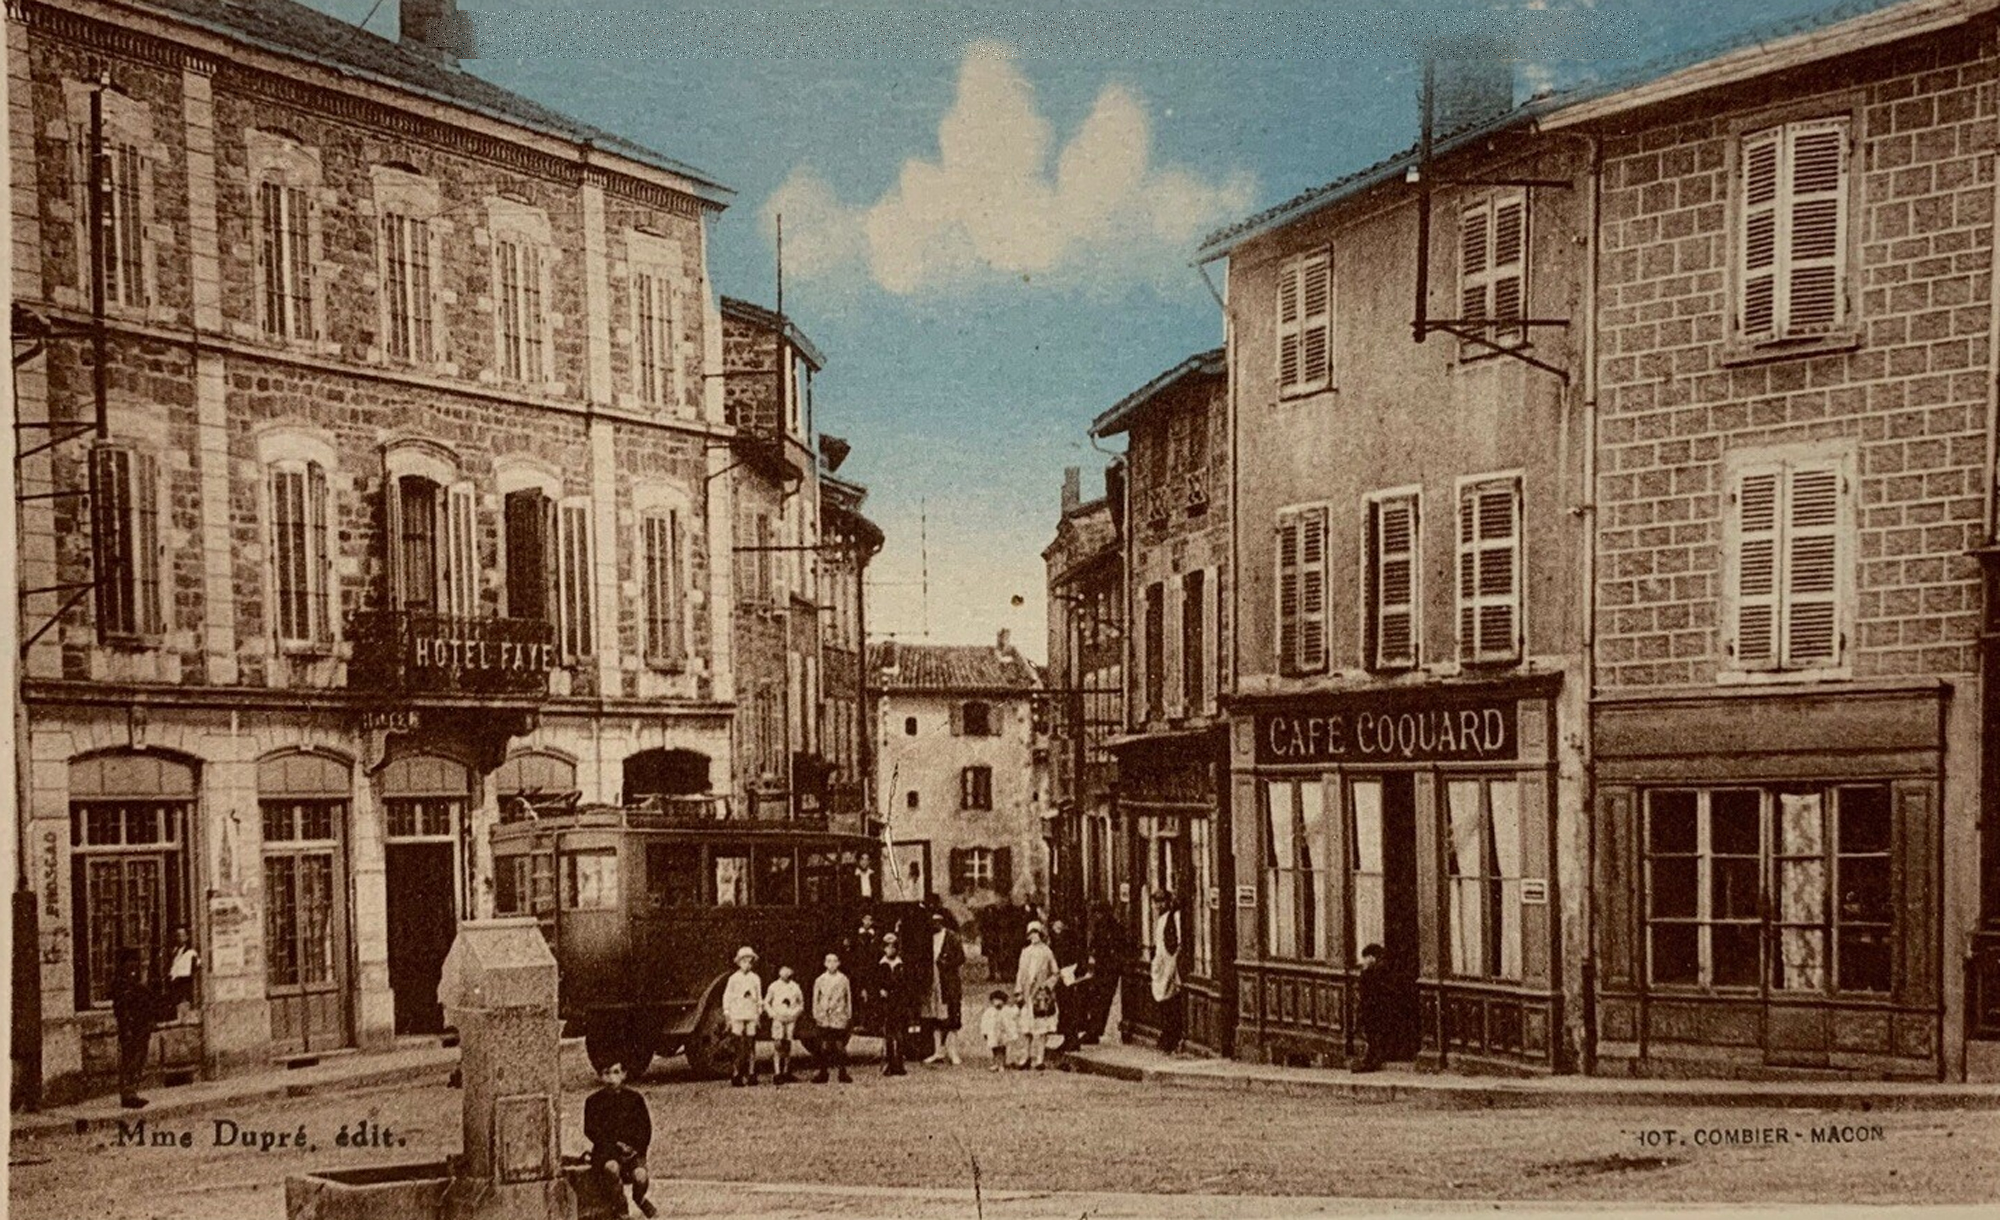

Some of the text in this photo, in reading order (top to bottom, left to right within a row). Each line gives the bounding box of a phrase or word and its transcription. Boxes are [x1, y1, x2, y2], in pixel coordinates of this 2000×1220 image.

[416, 638, 551, 671] HOTEL FAYE
[1358, 709, 1505, 757] COQUARD
